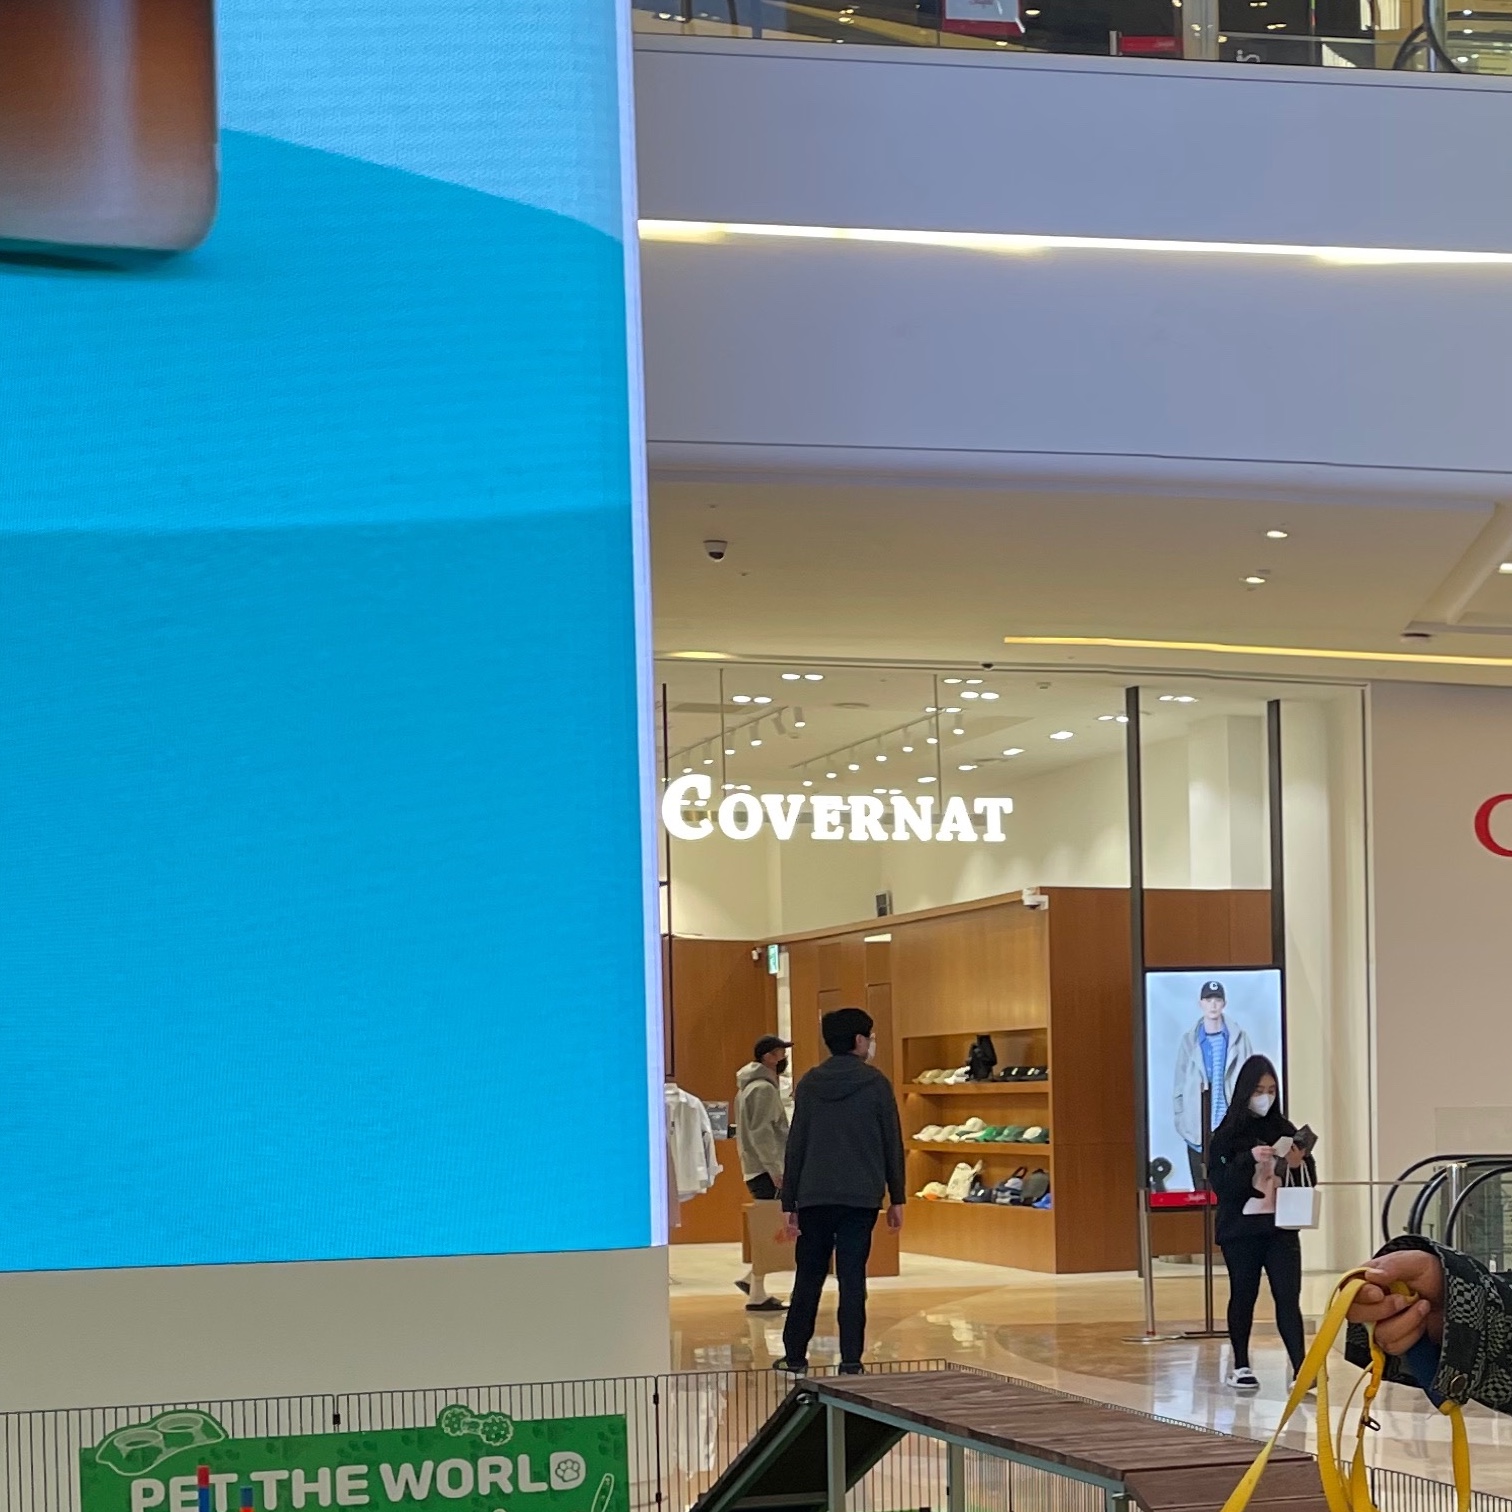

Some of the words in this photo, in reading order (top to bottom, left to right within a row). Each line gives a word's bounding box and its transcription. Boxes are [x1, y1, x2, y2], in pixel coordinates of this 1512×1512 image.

[662, 774, 1014, 842] COVERNAT
[250, 1464, 369, 1510] THE
[379, 1452, 586, 1502] WORLD
